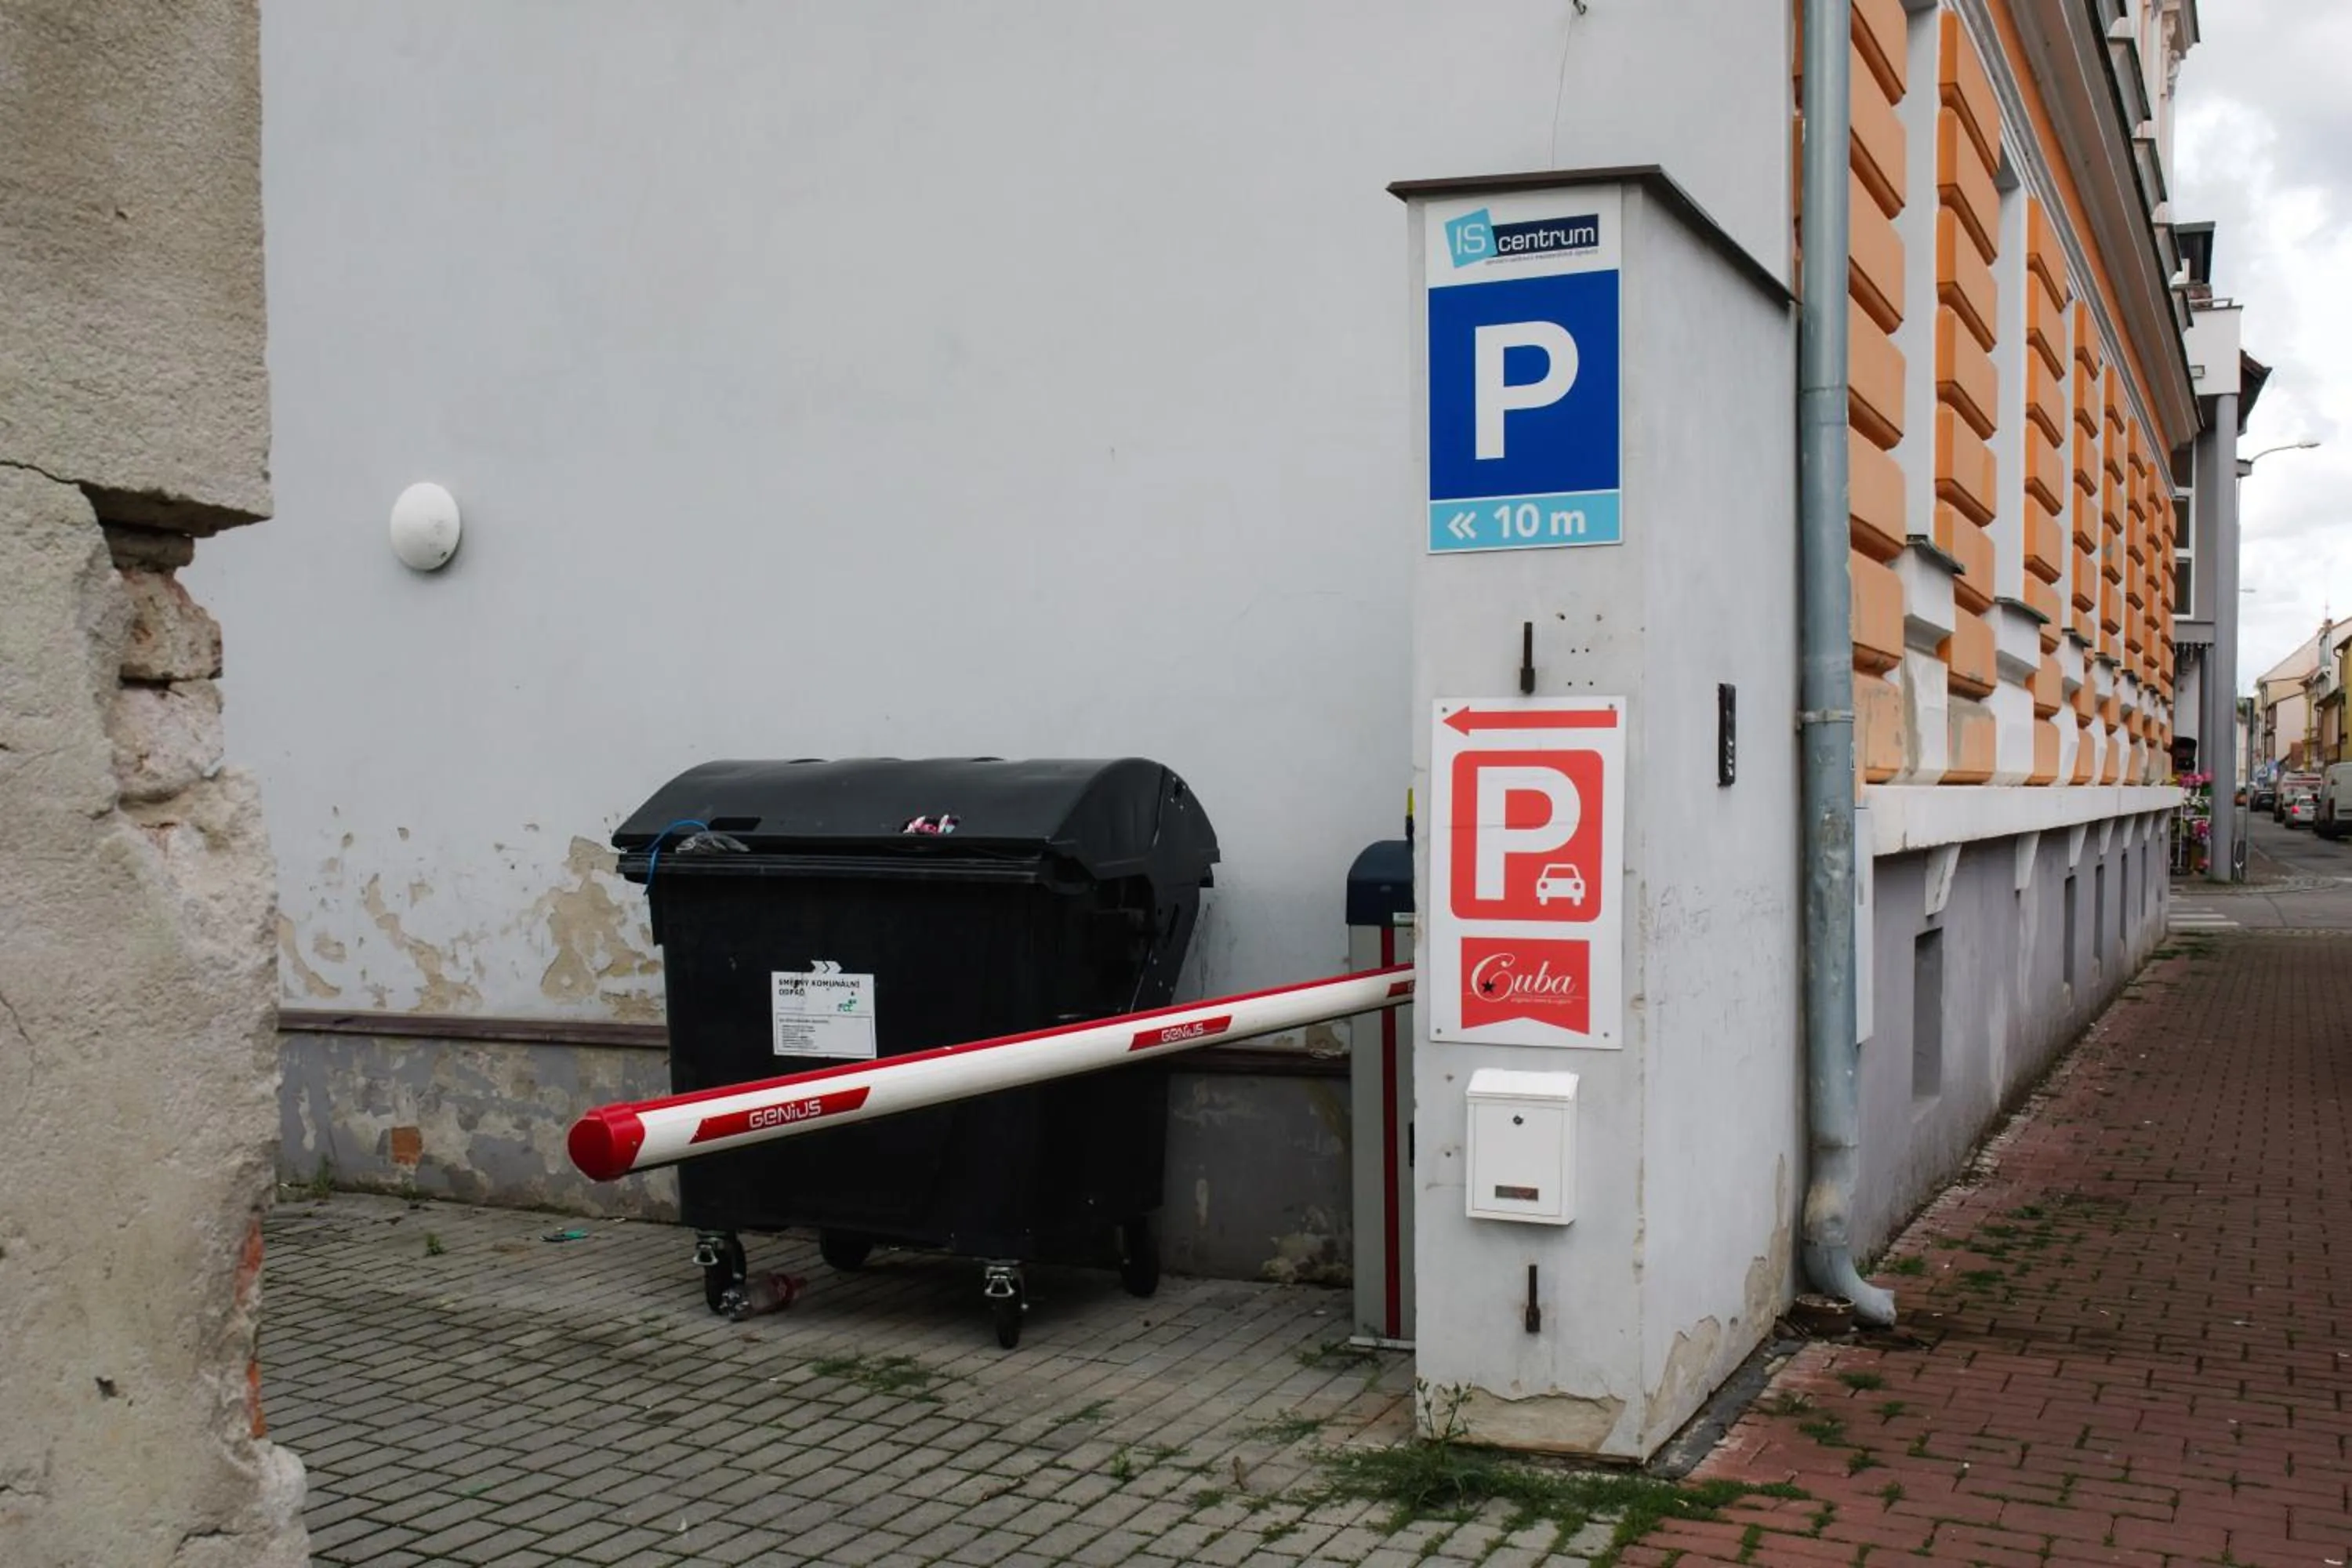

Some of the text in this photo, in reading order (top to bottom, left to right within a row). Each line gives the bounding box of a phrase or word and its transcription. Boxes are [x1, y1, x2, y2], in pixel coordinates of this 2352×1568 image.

[1456, 223, 1595, 255] IS centrum
[1475, 321, 1579, 460] P
[1494, 503, 1585, 539] 10 m
[1475, 766, 1581, 900] P
[1471, 953, 1575, 1003] Cuba
